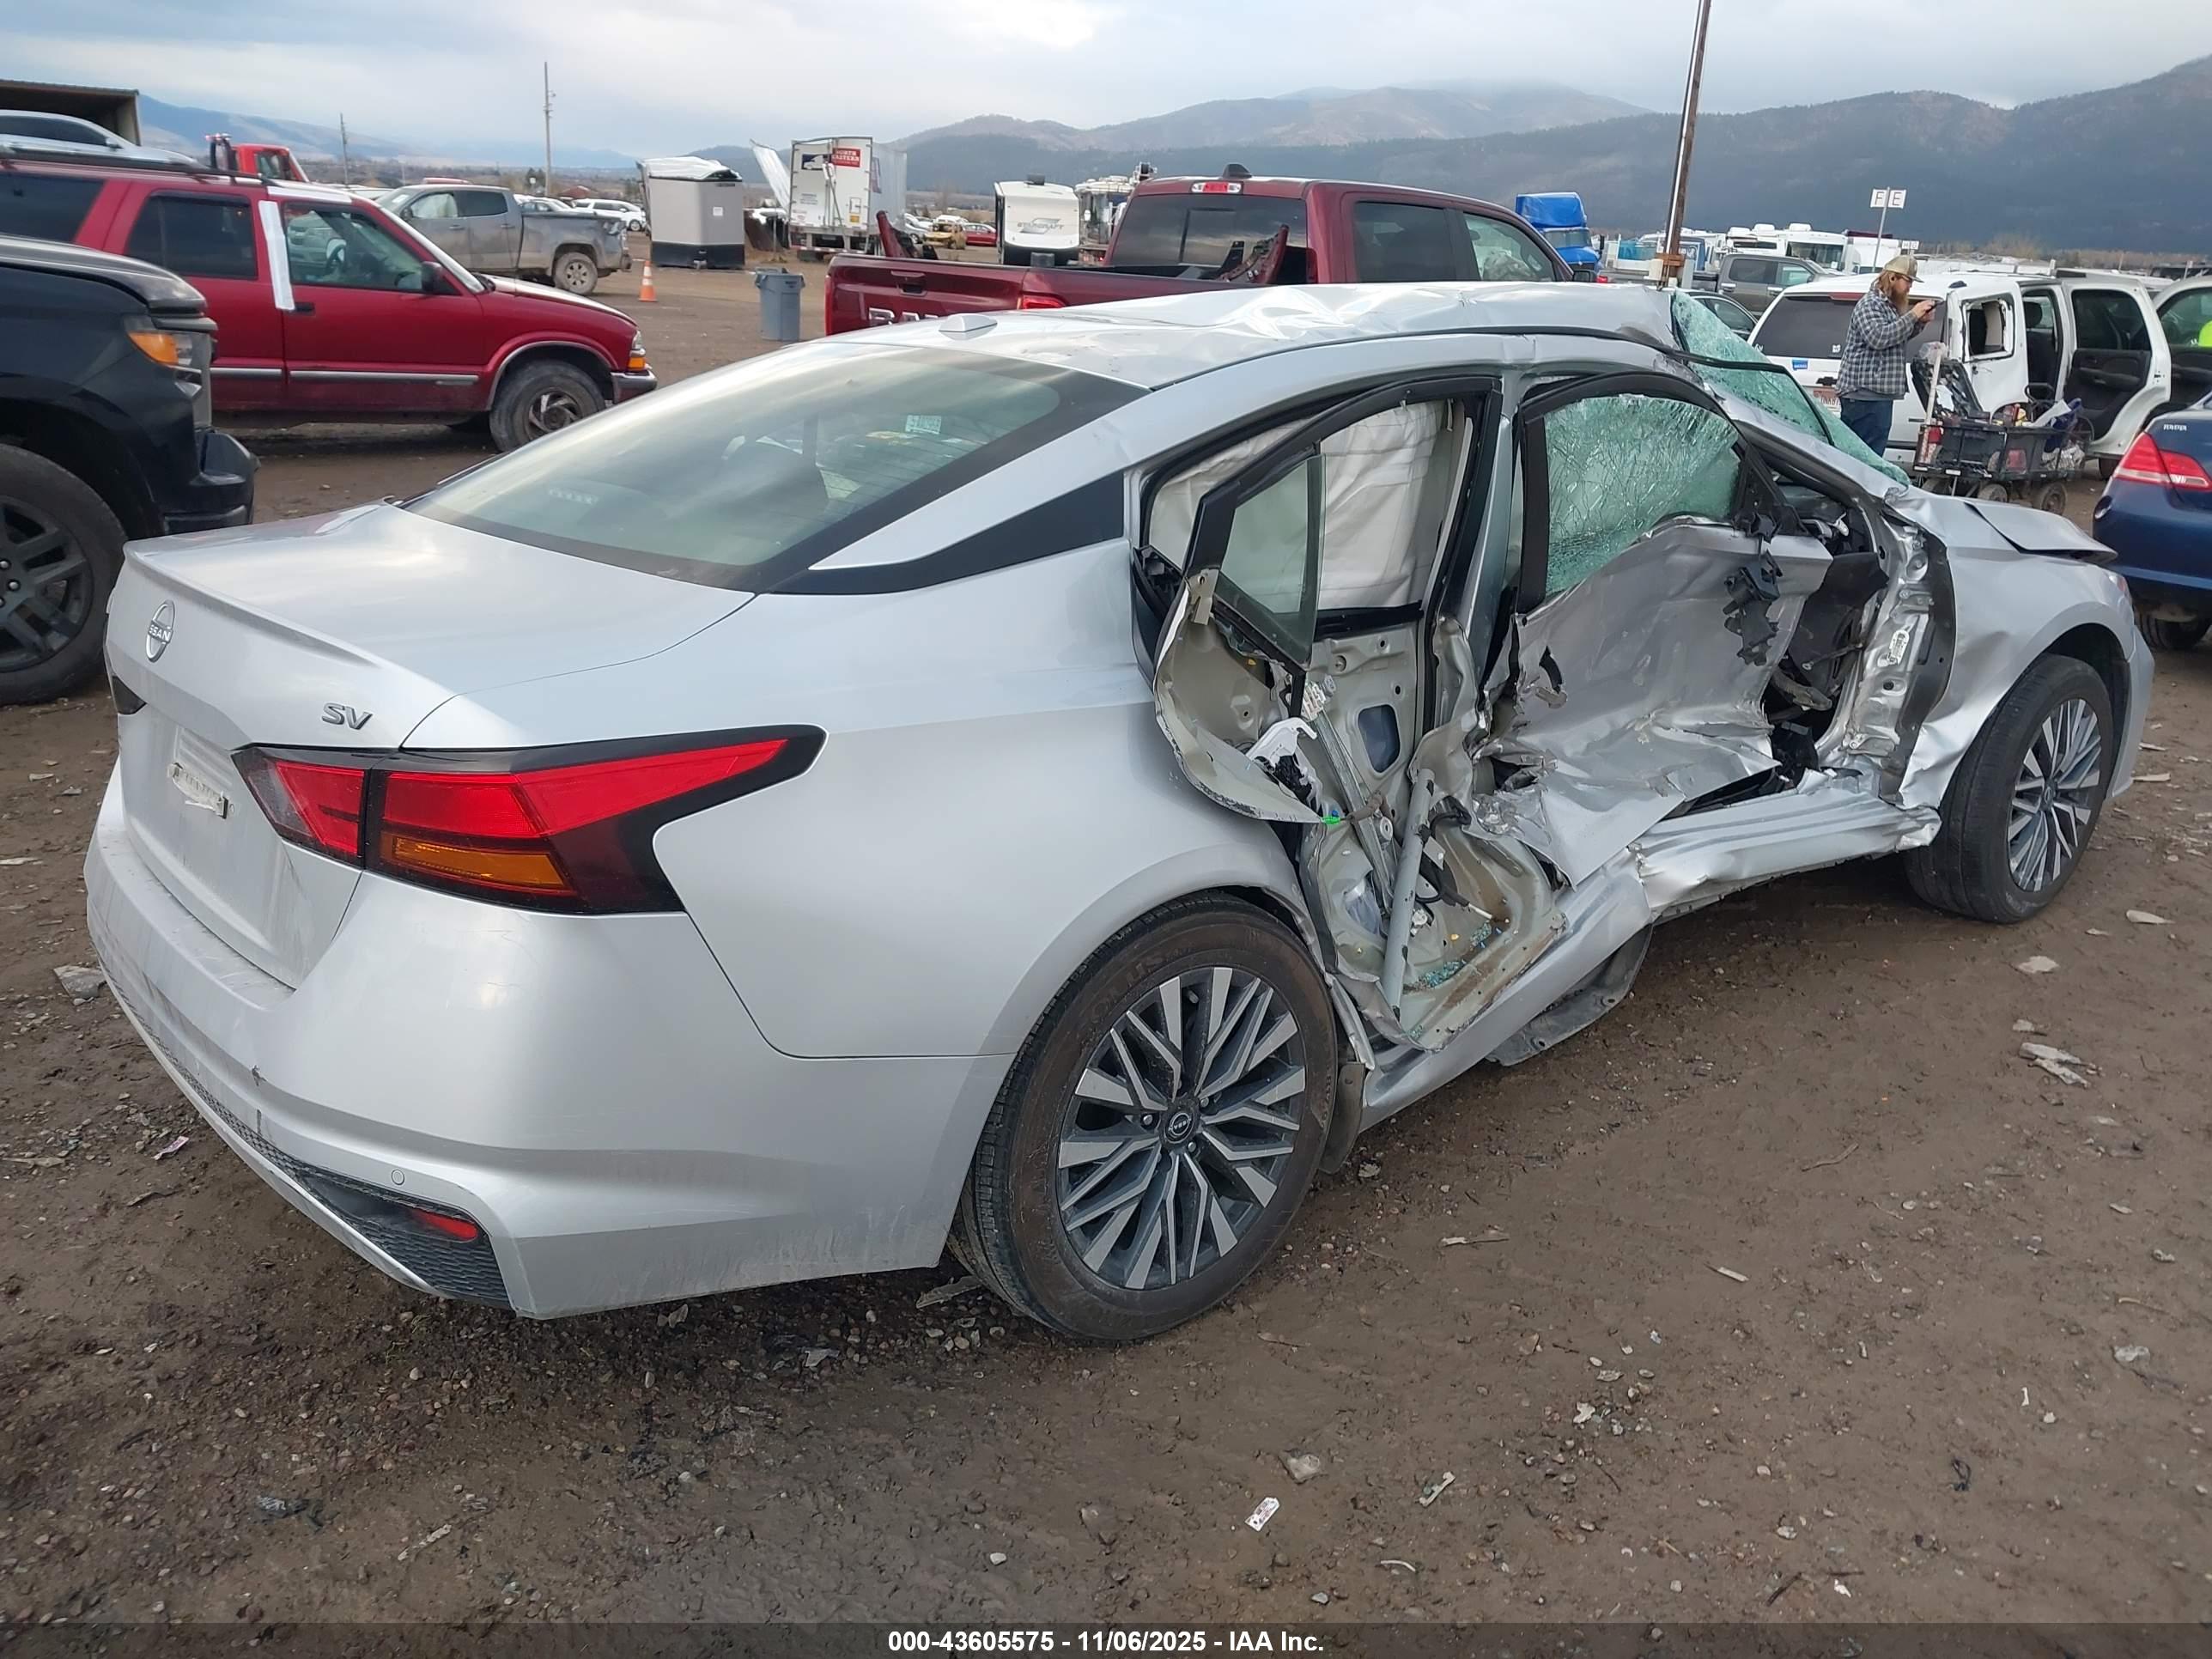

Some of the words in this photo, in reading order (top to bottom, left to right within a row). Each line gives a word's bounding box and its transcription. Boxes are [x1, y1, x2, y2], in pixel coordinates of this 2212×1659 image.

[1875, 191, 1885, 205] F
[1892, 191, 1903, 206] E
[321, 702, 373, 730] SV
